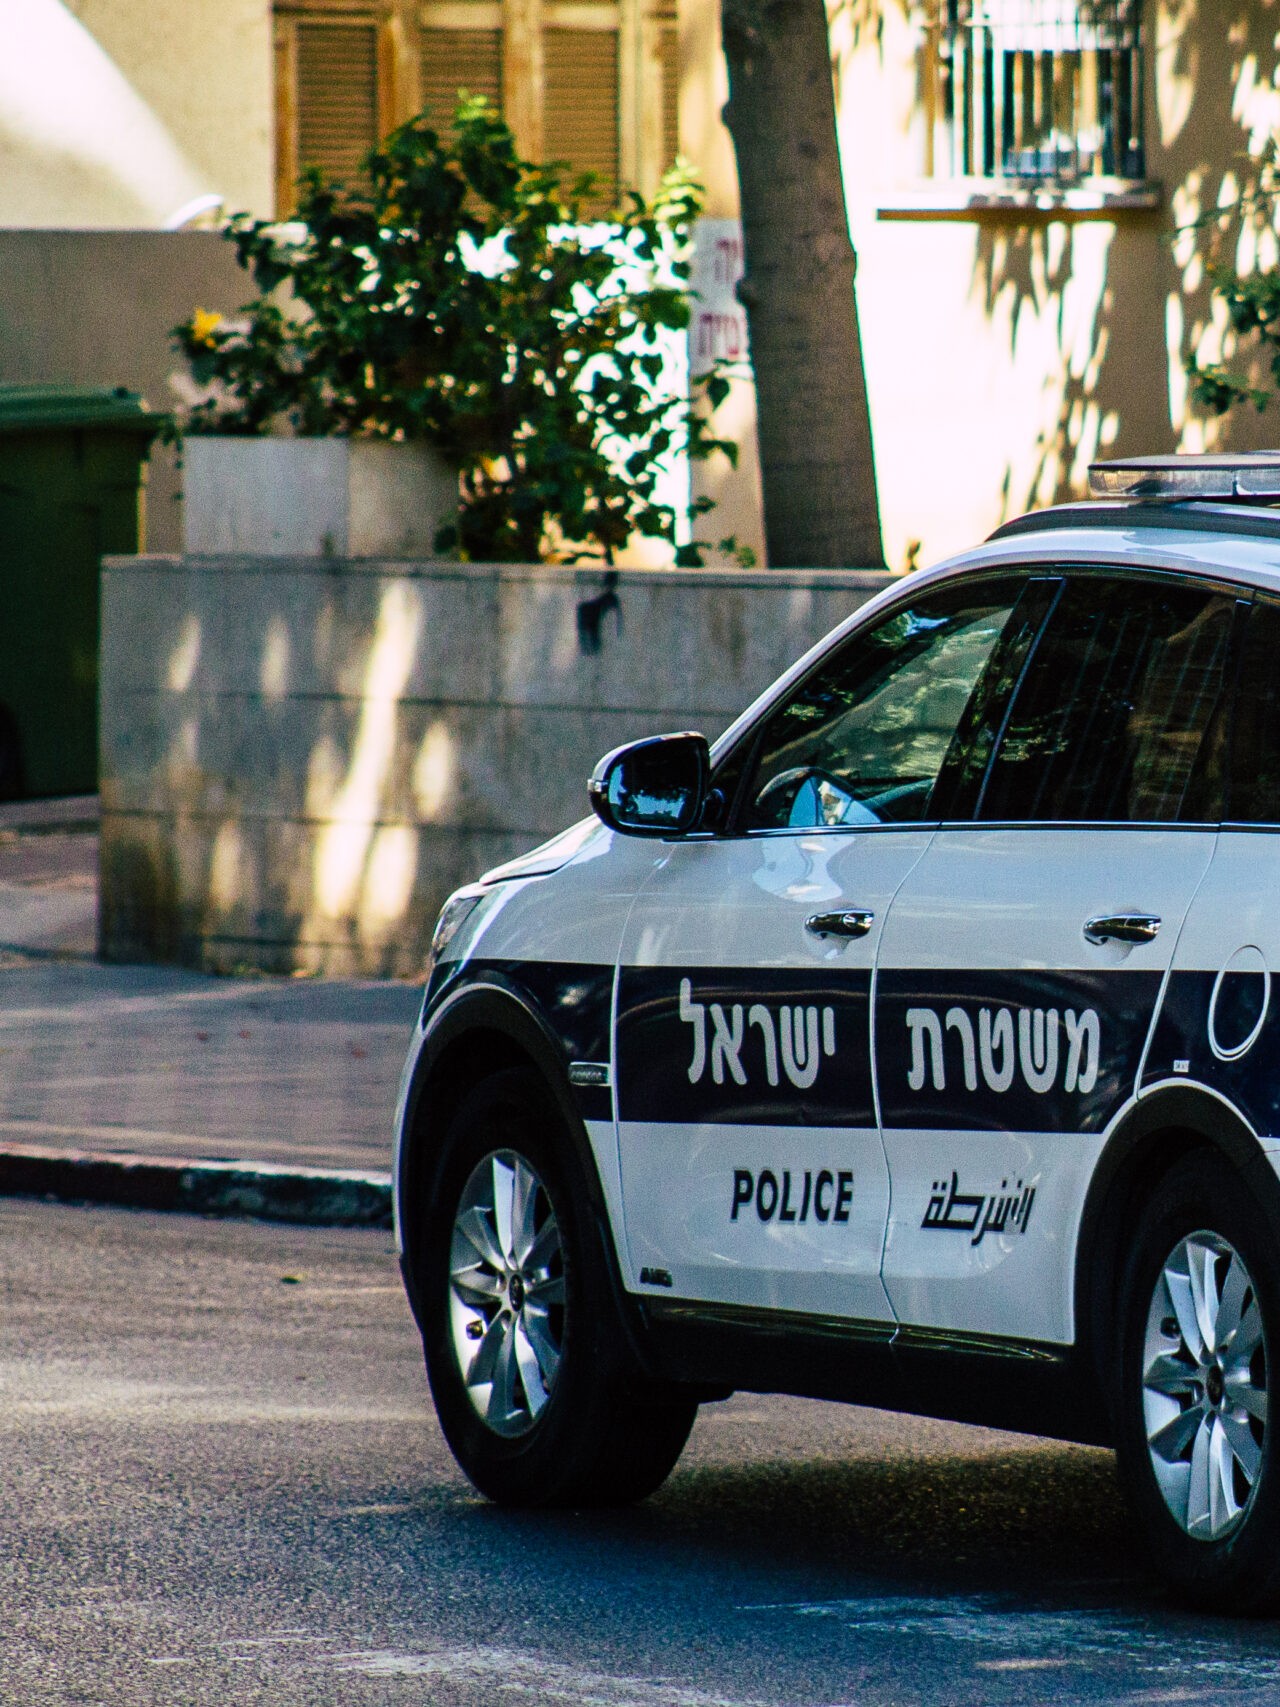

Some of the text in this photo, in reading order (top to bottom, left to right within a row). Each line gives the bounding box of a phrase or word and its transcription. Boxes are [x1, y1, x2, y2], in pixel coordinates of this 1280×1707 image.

[680, 976, 1101, 1094] משטרת ישראל
[730, 1168, 853, 1222] POLICE
[920, 1169, 1036, 1247] الشرطة
